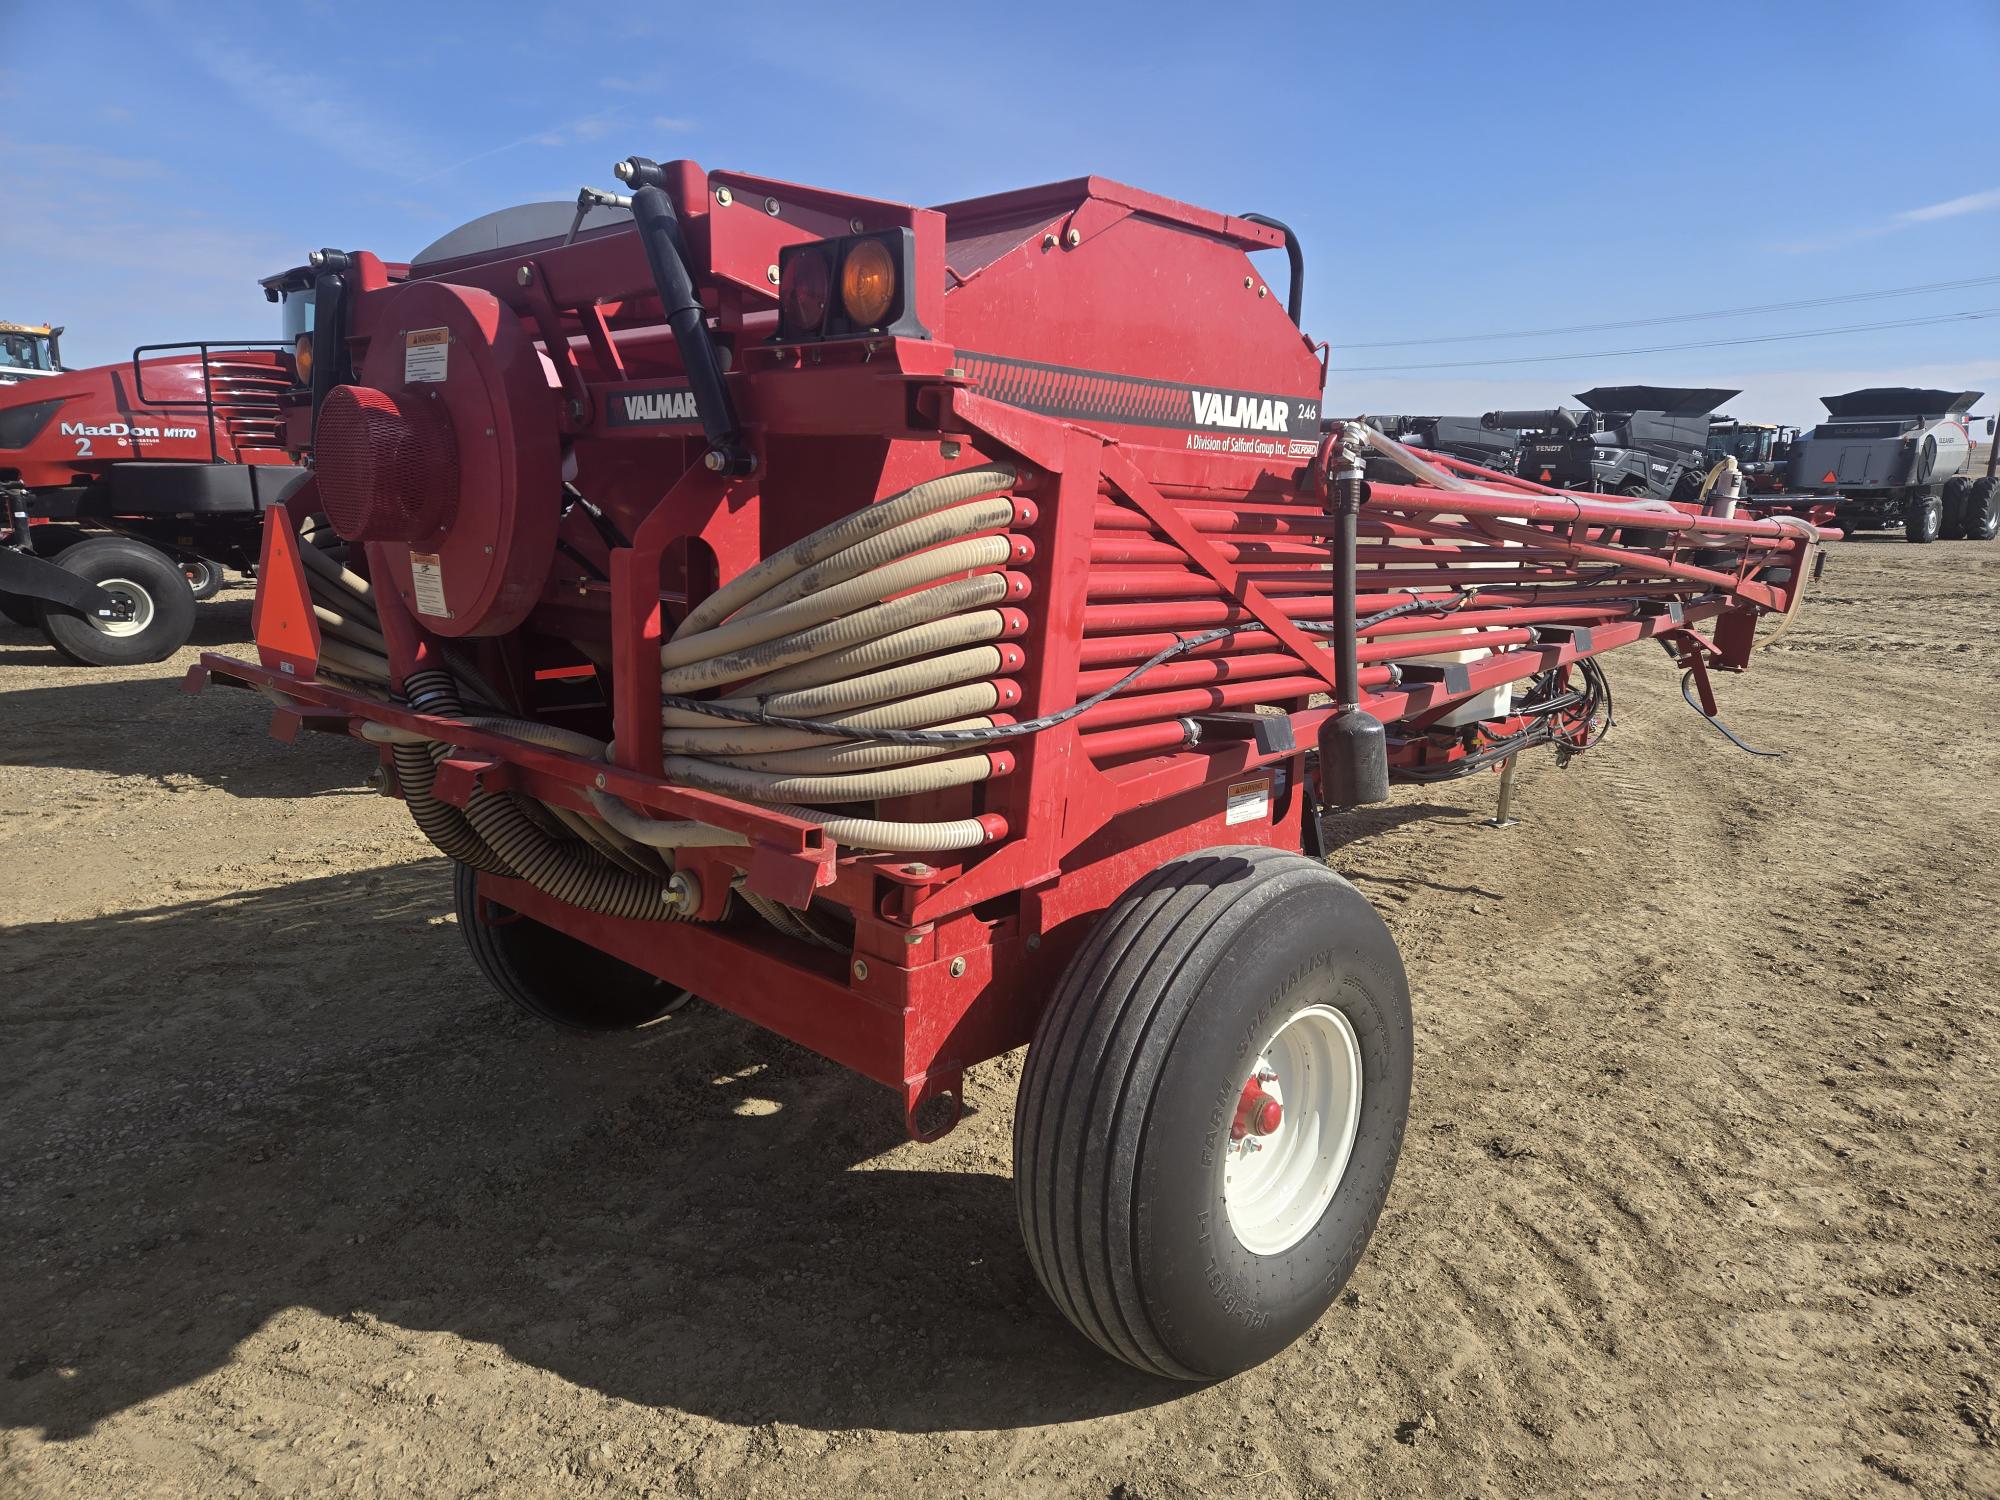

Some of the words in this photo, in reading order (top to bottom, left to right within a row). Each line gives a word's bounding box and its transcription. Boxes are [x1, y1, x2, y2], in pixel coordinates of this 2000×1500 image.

[623, 392, 698, 421] VALMAR
[1191, 390, 1289, 432] VALMAR
[1297, 403, 1317, 420] 246
[60, 422, 160, 437] MacDon
[163, 428, 197, 438] M1170
[75, 437, 93, 456] 2
[1186, 434, 1193, 449] A
[1193, 435, 1221, 451] Division
[1222, 437, 1231, 451] of
[1230, 437, 1254, 454] Salford
[1254, 440, 1275, 457] Group
[1275, 441, 1287, 455] Inc.
[1290, 444, 1317, 455] SALFORD
[1201, 1073, 1233, 1167] FARM
[1236, 950, 1333, 1060] SPECIALIST
[1326, 1117, 1406, 1294] CARLISLE
